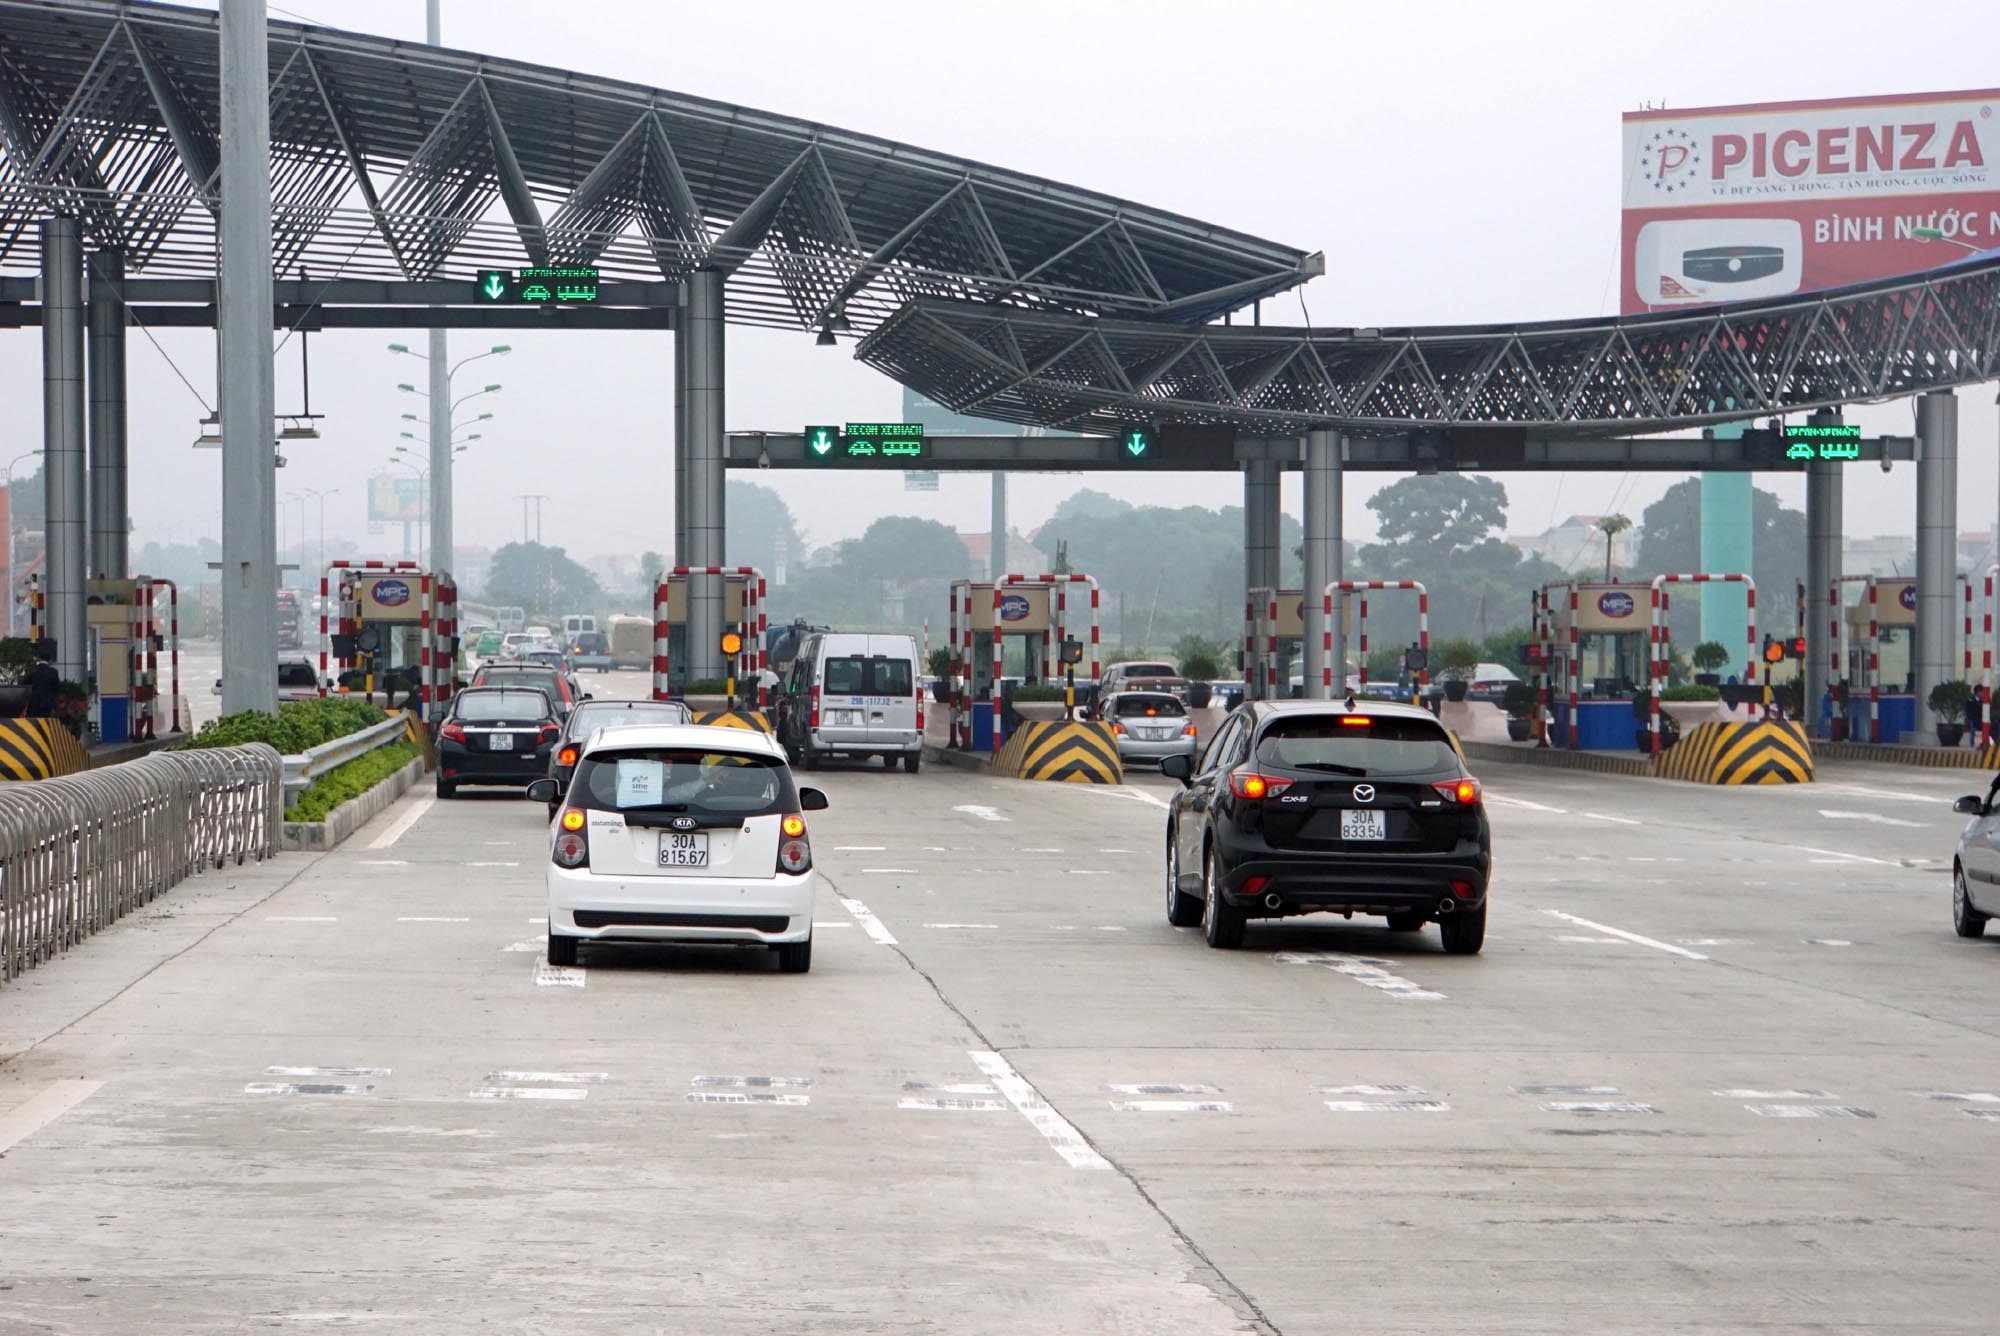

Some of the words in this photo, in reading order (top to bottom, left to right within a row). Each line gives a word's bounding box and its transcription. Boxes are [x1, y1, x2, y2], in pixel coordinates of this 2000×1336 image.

[1711, 119, 1984, 180] PICENZA
[1815, 213, 1883, 243] BÌNH
[376, 586, 408, 597] MPC
[675, 819, 694, 827] KIA
[1351, 810, 1375, 824] 30A
[671, 834, 696, 849] 30A
[661, 849, 706, 865] 815.67
